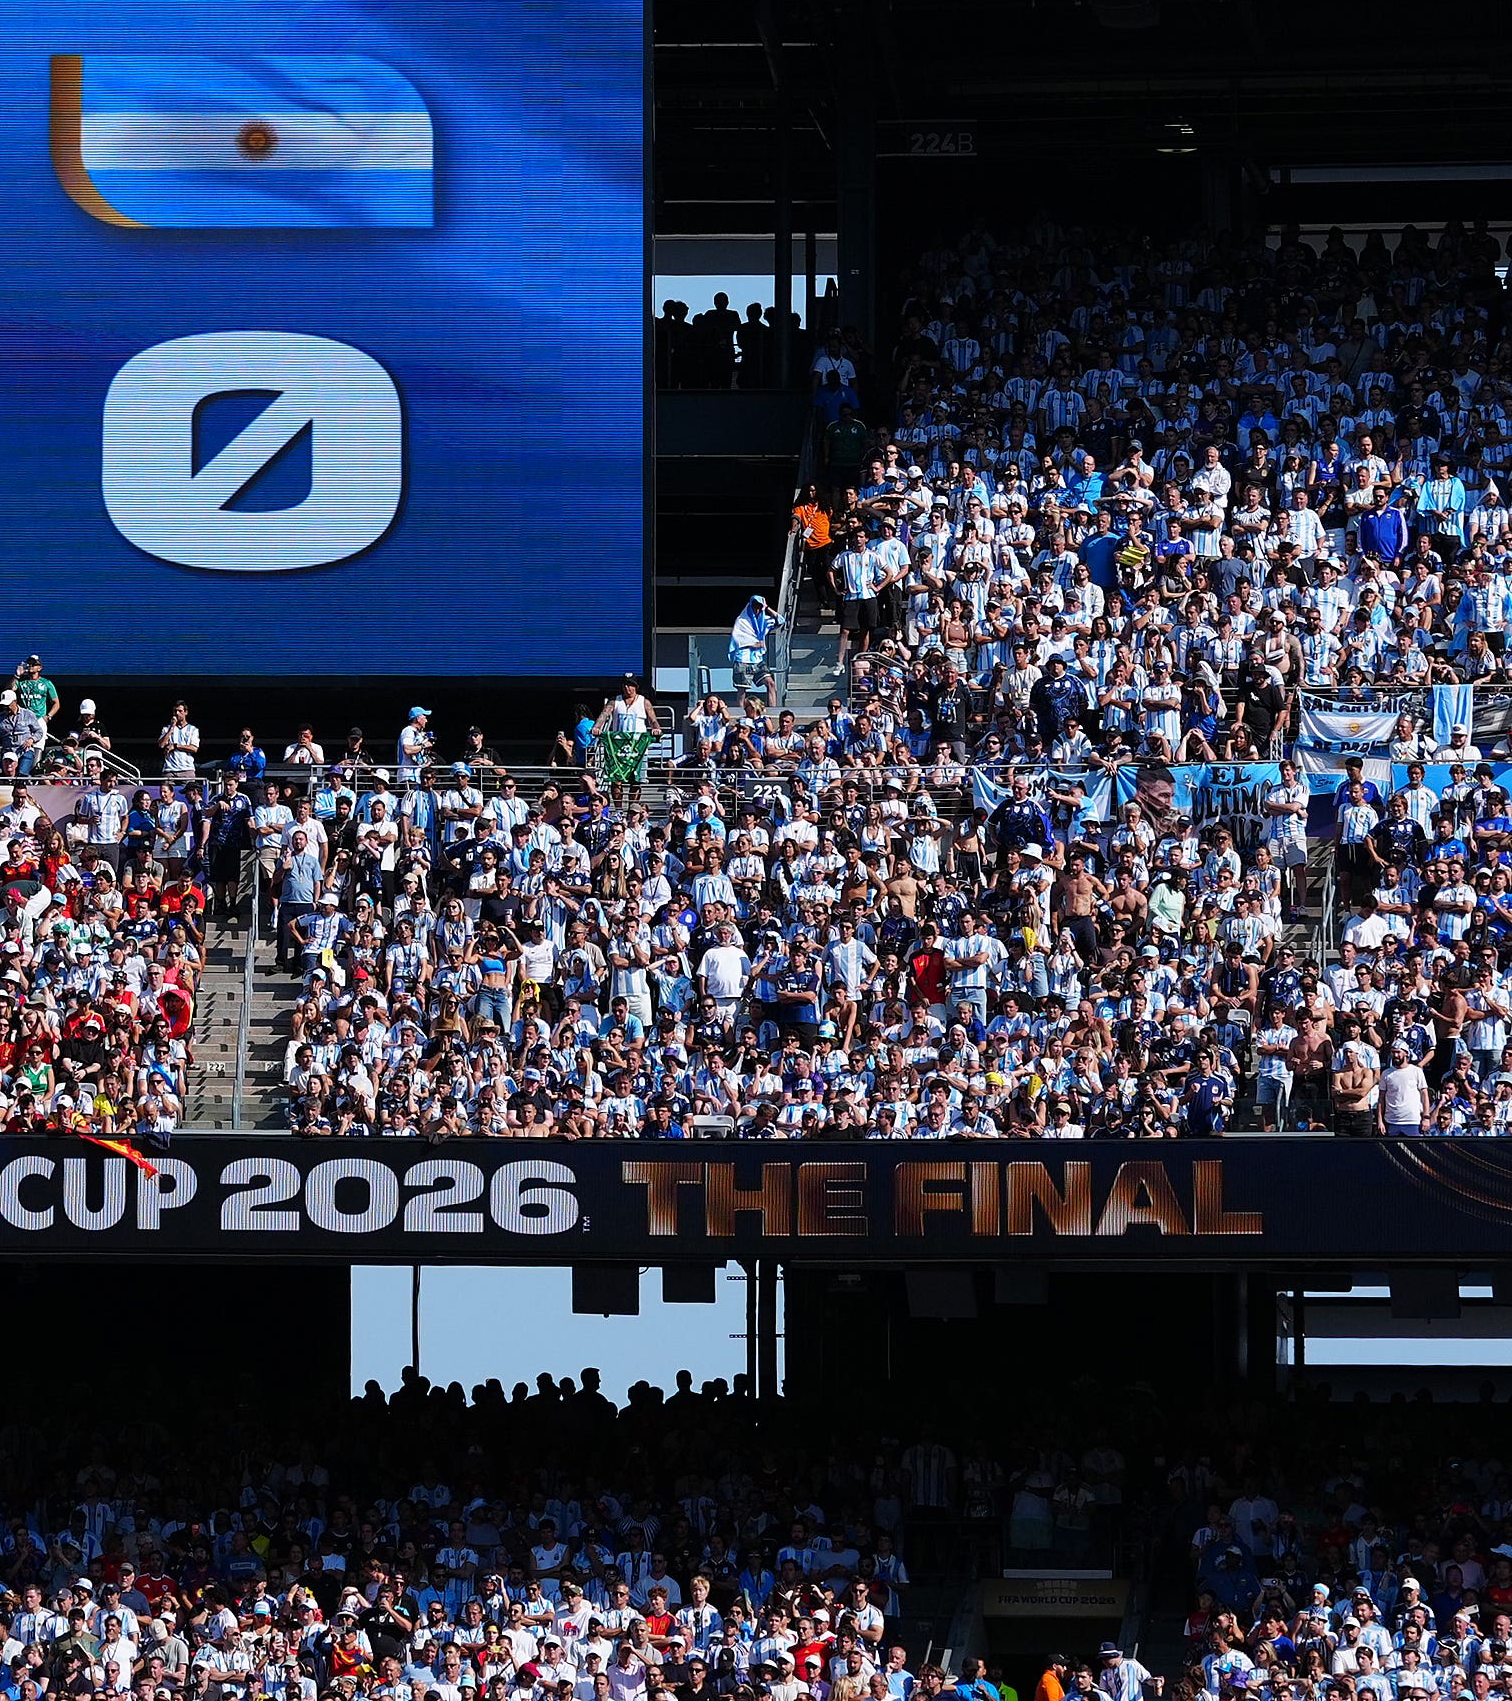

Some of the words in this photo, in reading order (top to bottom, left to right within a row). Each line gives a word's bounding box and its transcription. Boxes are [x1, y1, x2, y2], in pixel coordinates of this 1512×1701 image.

[911, 133, 973, 155] 224B
[102, 331, 402, 571] 0
[1210, 765, 1252, 786] EL
[208, 1062, 225, 1072] 222
[219, 1157, 580, 1236] 2026
[620, 1160, 869, 1237] THE
[893, 1159, 1265, 1238] FINAL
[997, 1595, 1019, 1605] FIFA
[1021, 1595, 1058, 1606] WORLD
[1060, 1595, 1080, 1606] CUP
[1081, 1595, 1118, 1606] 2026
